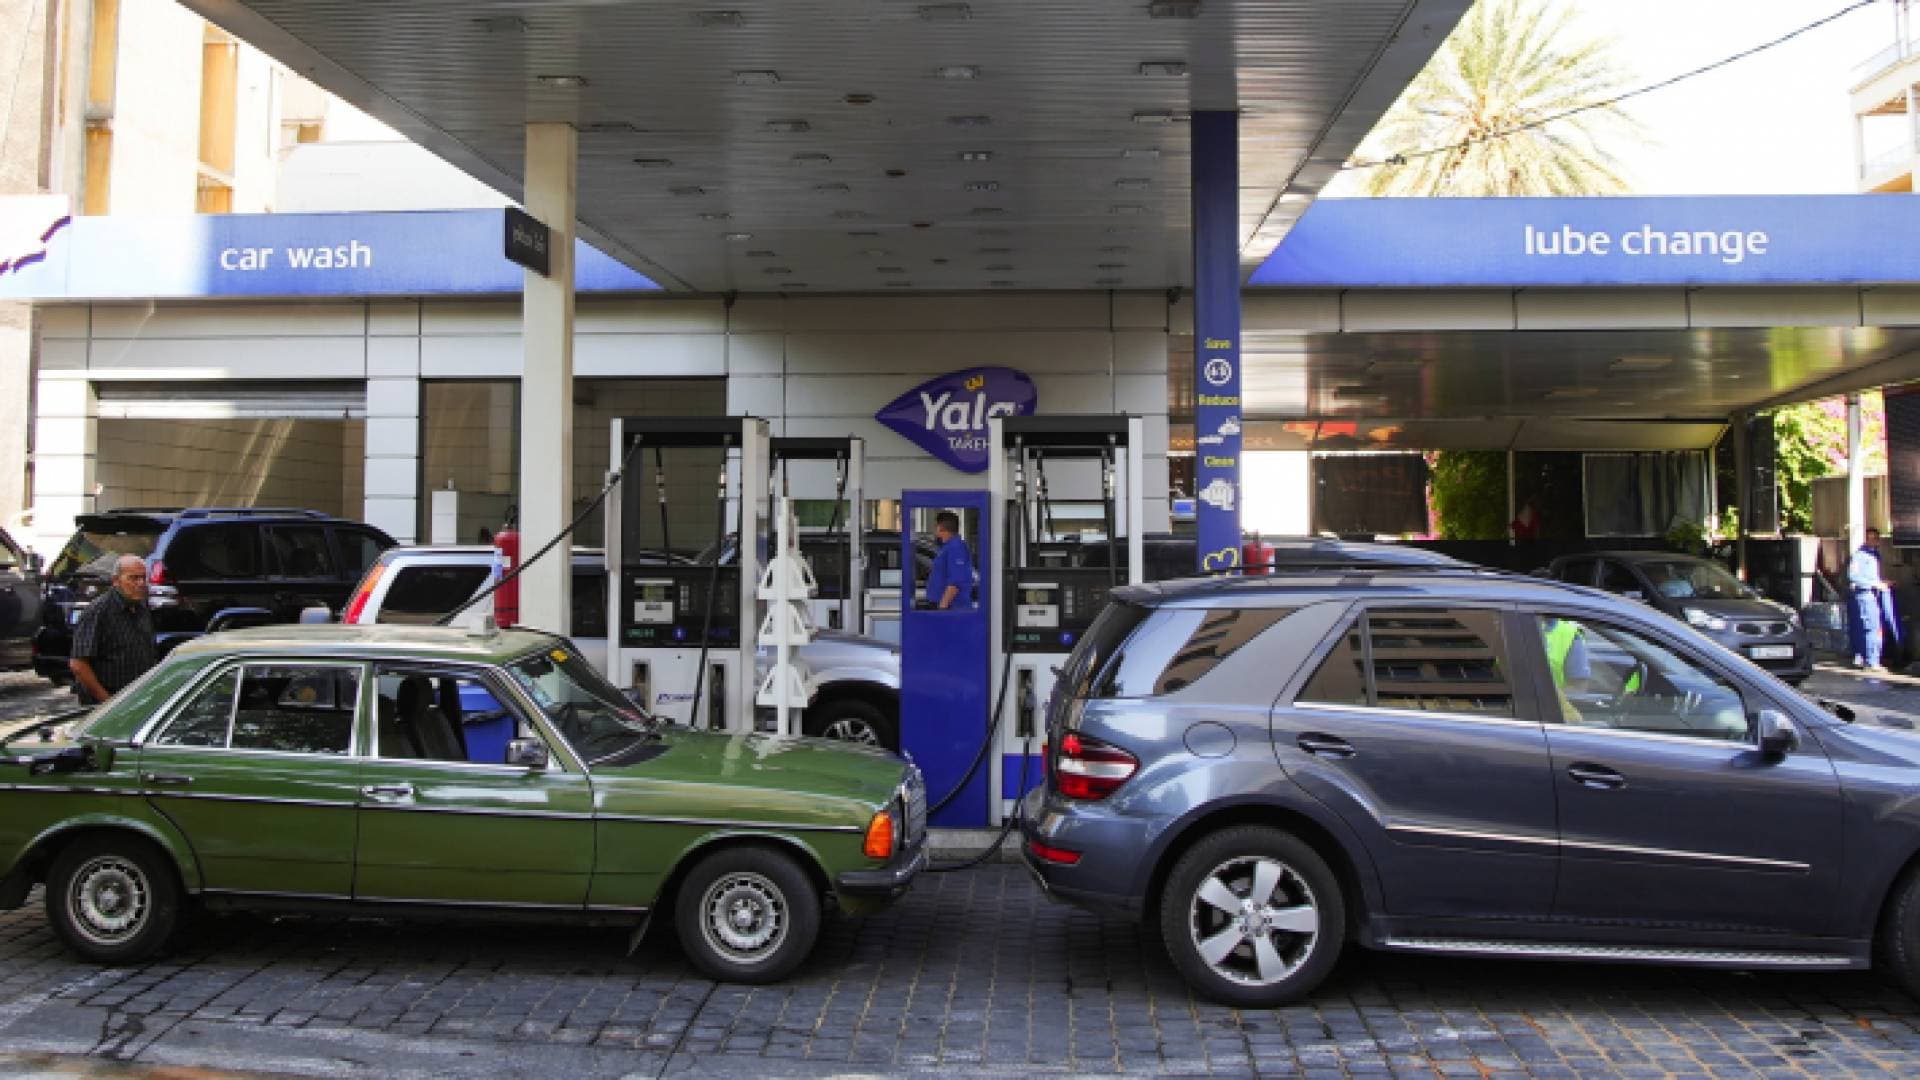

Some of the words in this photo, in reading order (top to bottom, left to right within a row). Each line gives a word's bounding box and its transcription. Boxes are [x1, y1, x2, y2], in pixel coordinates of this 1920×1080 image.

[220, 248, 273, 271] car
[287, 239, 371, 268] wash
[1525, 223, 1610, 254] lube
[1621, 223, 1769, 263] change
